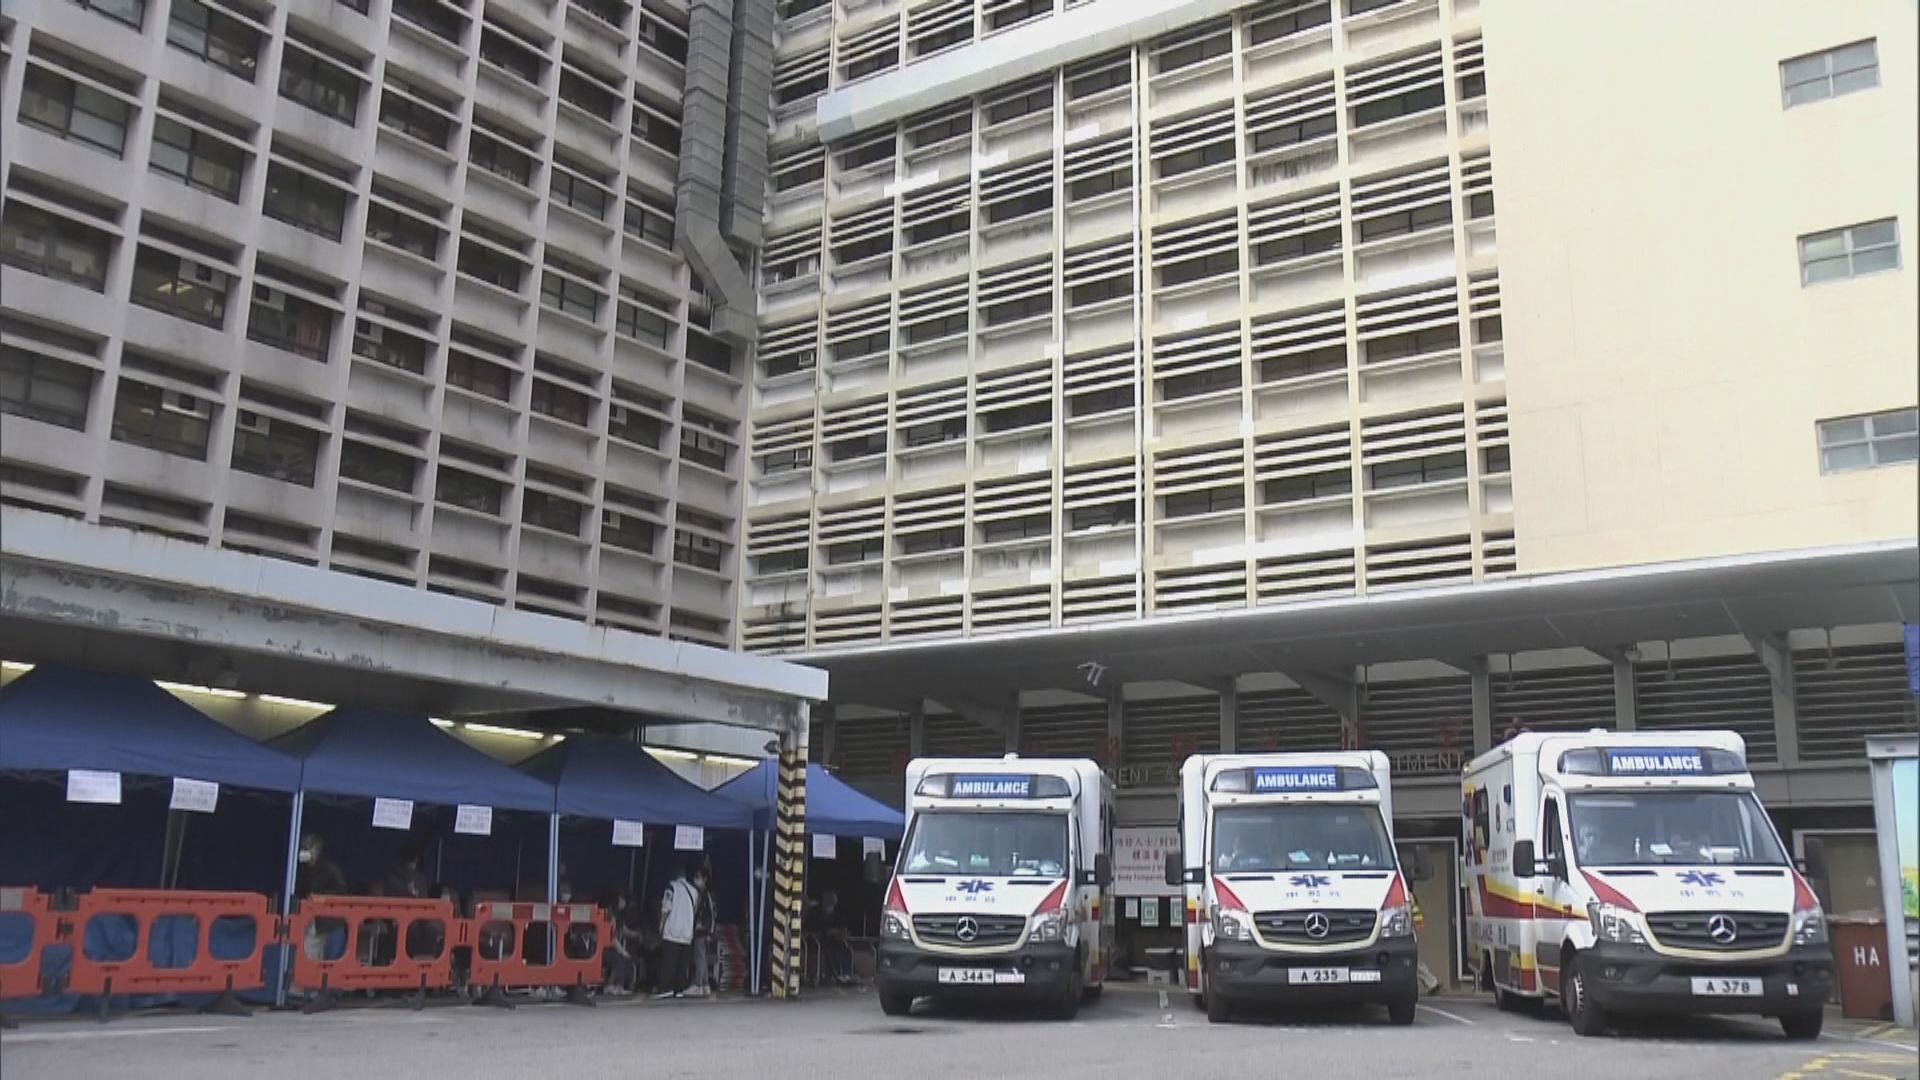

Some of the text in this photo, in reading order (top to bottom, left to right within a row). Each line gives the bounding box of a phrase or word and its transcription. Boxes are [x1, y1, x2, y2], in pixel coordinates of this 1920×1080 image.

[1391, 751, 1462, 773] TMENT
[1612, 755, 1703, 770] AMBULANCE
[1106, 767, 1151, 784] DENT
[1256, 773, 1336, 788] AMBULANCE
[953, 781, 1029, 794] AMBULANCE
[1854, 945, 1880, 966] HA
[949, 970, 957, 981] A
[962, 970, 984, 981] 344
[1301, 970, 1309, 982] A
[1313, 969, 1338, 981] 235
[1706, 981, 1751, 993] A 378
